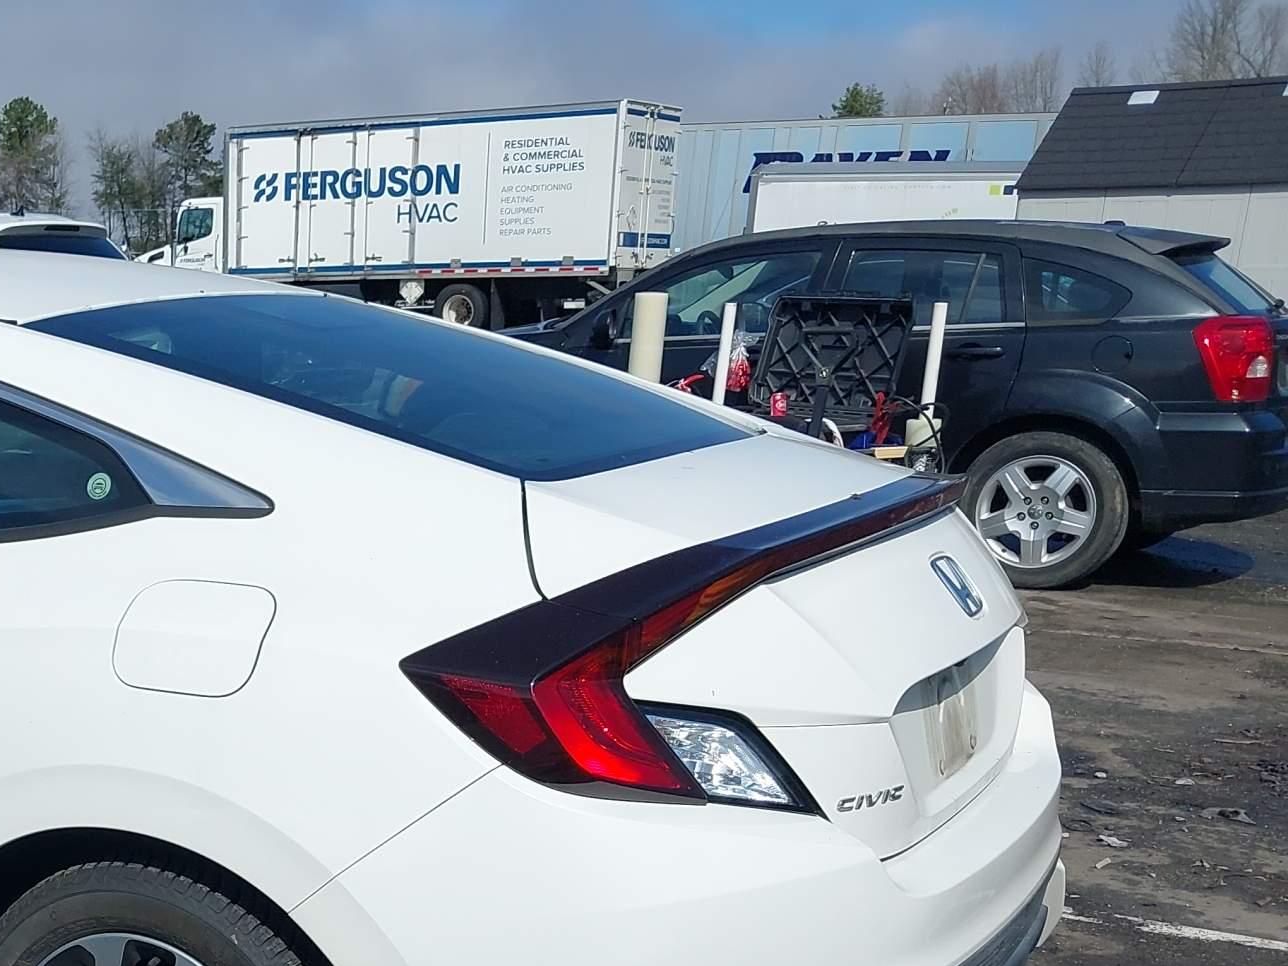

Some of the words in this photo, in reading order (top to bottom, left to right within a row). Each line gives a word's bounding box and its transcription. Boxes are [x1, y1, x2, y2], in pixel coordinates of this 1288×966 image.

[504, 137, 570, 149] RESIDENTIAL
[503, 153, 510, 162] &
[513, 149, 584, 161] COMMERCIAL
[502, 165, 532, 174] HVAC
[535, 162, 585, 173] SUPPLIES
[284, 163, 461, 201] FERGUSON
[515, 183, 572, 193] CONDITIONING
[501, 196, 534, 204] HEATING
[397, 202, 458, 223] HVAC
[500, 206, 544, 215] EQUIPMENT
[500, 217, 535, 226] SUPPLIES
[500, 228, 525, 236] REPAIR
[527, 227, 552, 236] PARTS
[837, 785, 904, 812] CIVIC
